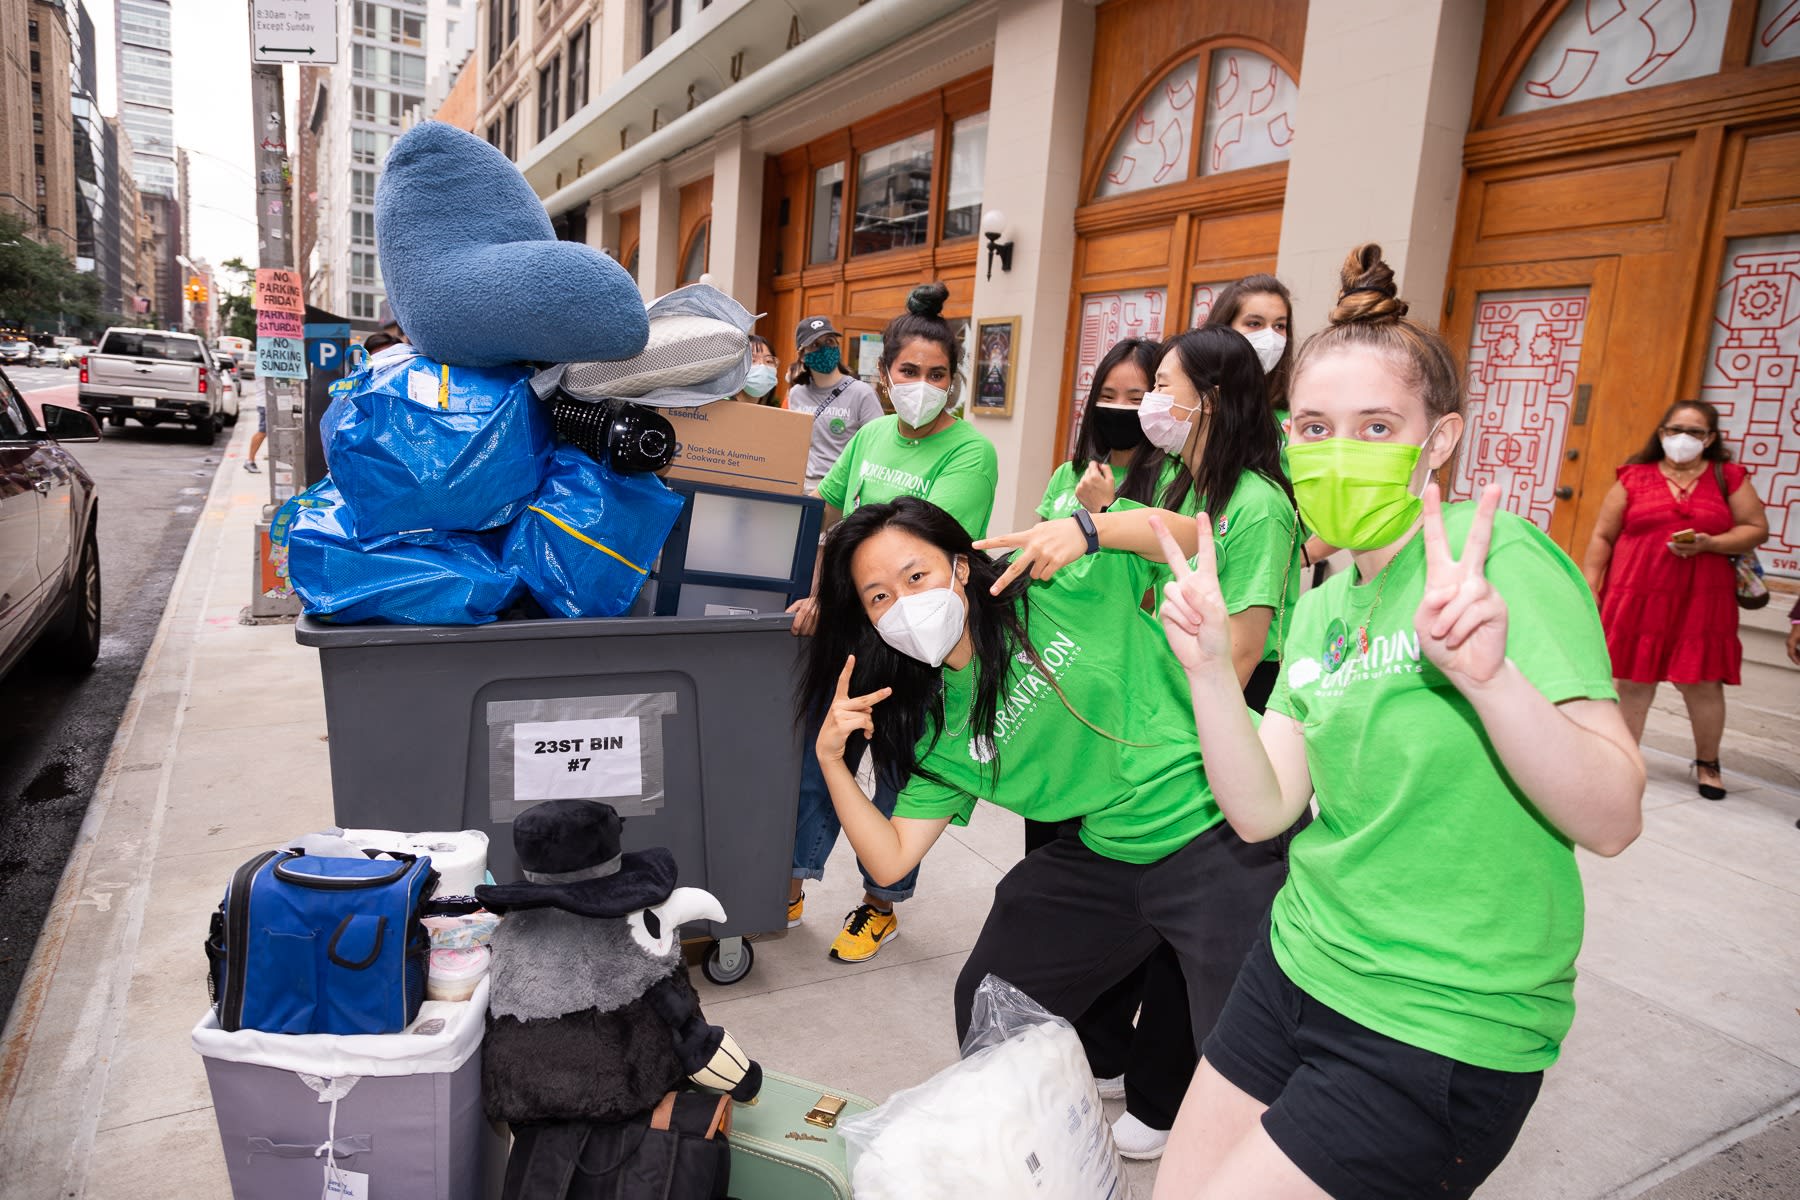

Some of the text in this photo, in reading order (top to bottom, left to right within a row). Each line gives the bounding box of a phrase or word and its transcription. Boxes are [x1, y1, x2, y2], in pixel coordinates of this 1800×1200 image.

[257, 9, 286, 19] 8:30am
[294, 11, 311, 20] 7pm
[257, 21, 315, 32] Except Sunday
[273, 271, 289, 282] NO
[259, 283, 300, 297] PARKING
[264, 295, 297, 307] FRIDAY
[260, 310, 300, 321] PARKING
[259, 322, 301, 333] SATURDAY
[273, 338, 289, 348] NO
[260, 349, 302, 361] PARKING
[320, 342, 336, 366] P
[261, 361, 301, 373] SUNDAY
[687, 444, 725, 456] Non-Stick
[727, 451, 766, 463] Aluminum
[686, 453, 740, 467] Cookware Set
[864, 463, 931, 494] ORIENTATION
[1384, 664, 1423, 675] ARTS
[1003, 646, 1082, 745] SCHOOL OF VISAL ARTS
[534, 736, 623, 755] 23ST BIN
[568, 758, 591, 772] #7
